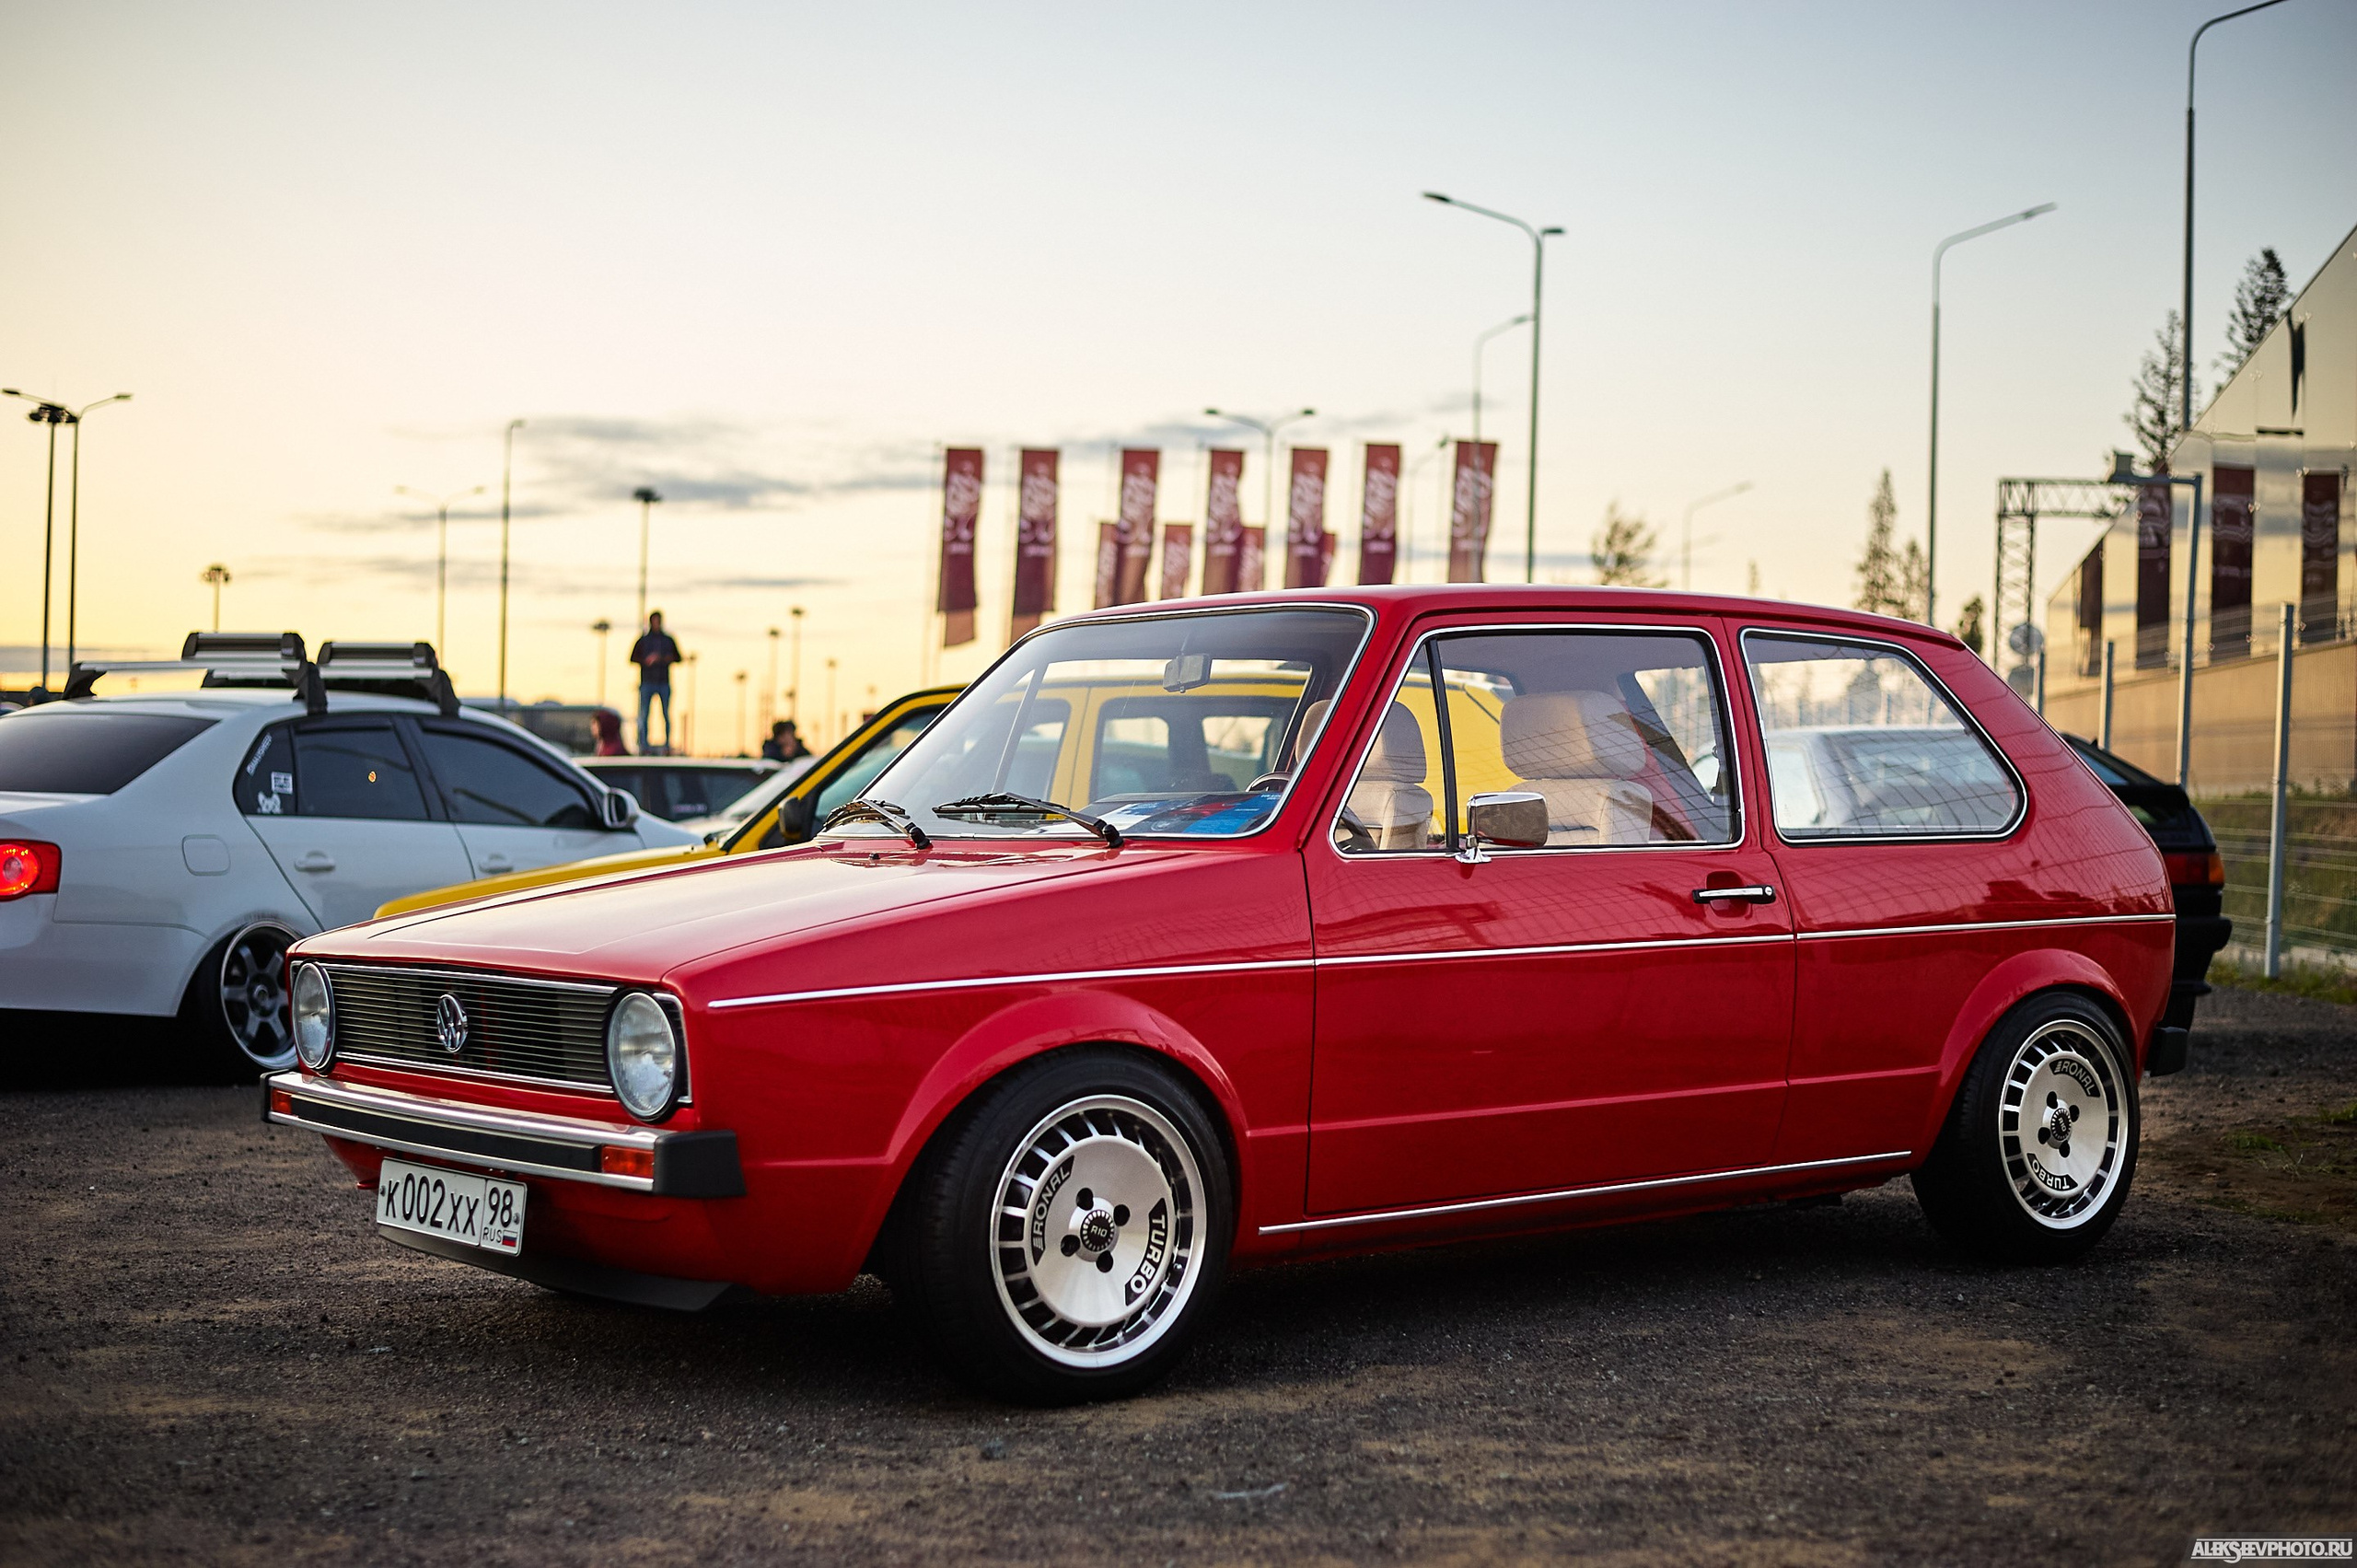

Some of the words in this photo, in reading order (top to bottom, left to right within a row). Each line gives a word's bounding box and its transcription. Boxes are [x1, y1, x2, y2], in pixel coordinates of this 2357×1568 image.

[2061, 1061, 2096, 1096] RONAL
[2032, 1159, 2070, 1190] TURBO
[488, 1187, 514, 1228] 98
[1032, 1167, 1071, 1237] RONAL
[482, 1226, 503, 1244] RUS
[1130, 1214, 1166, 1295] TURBO
